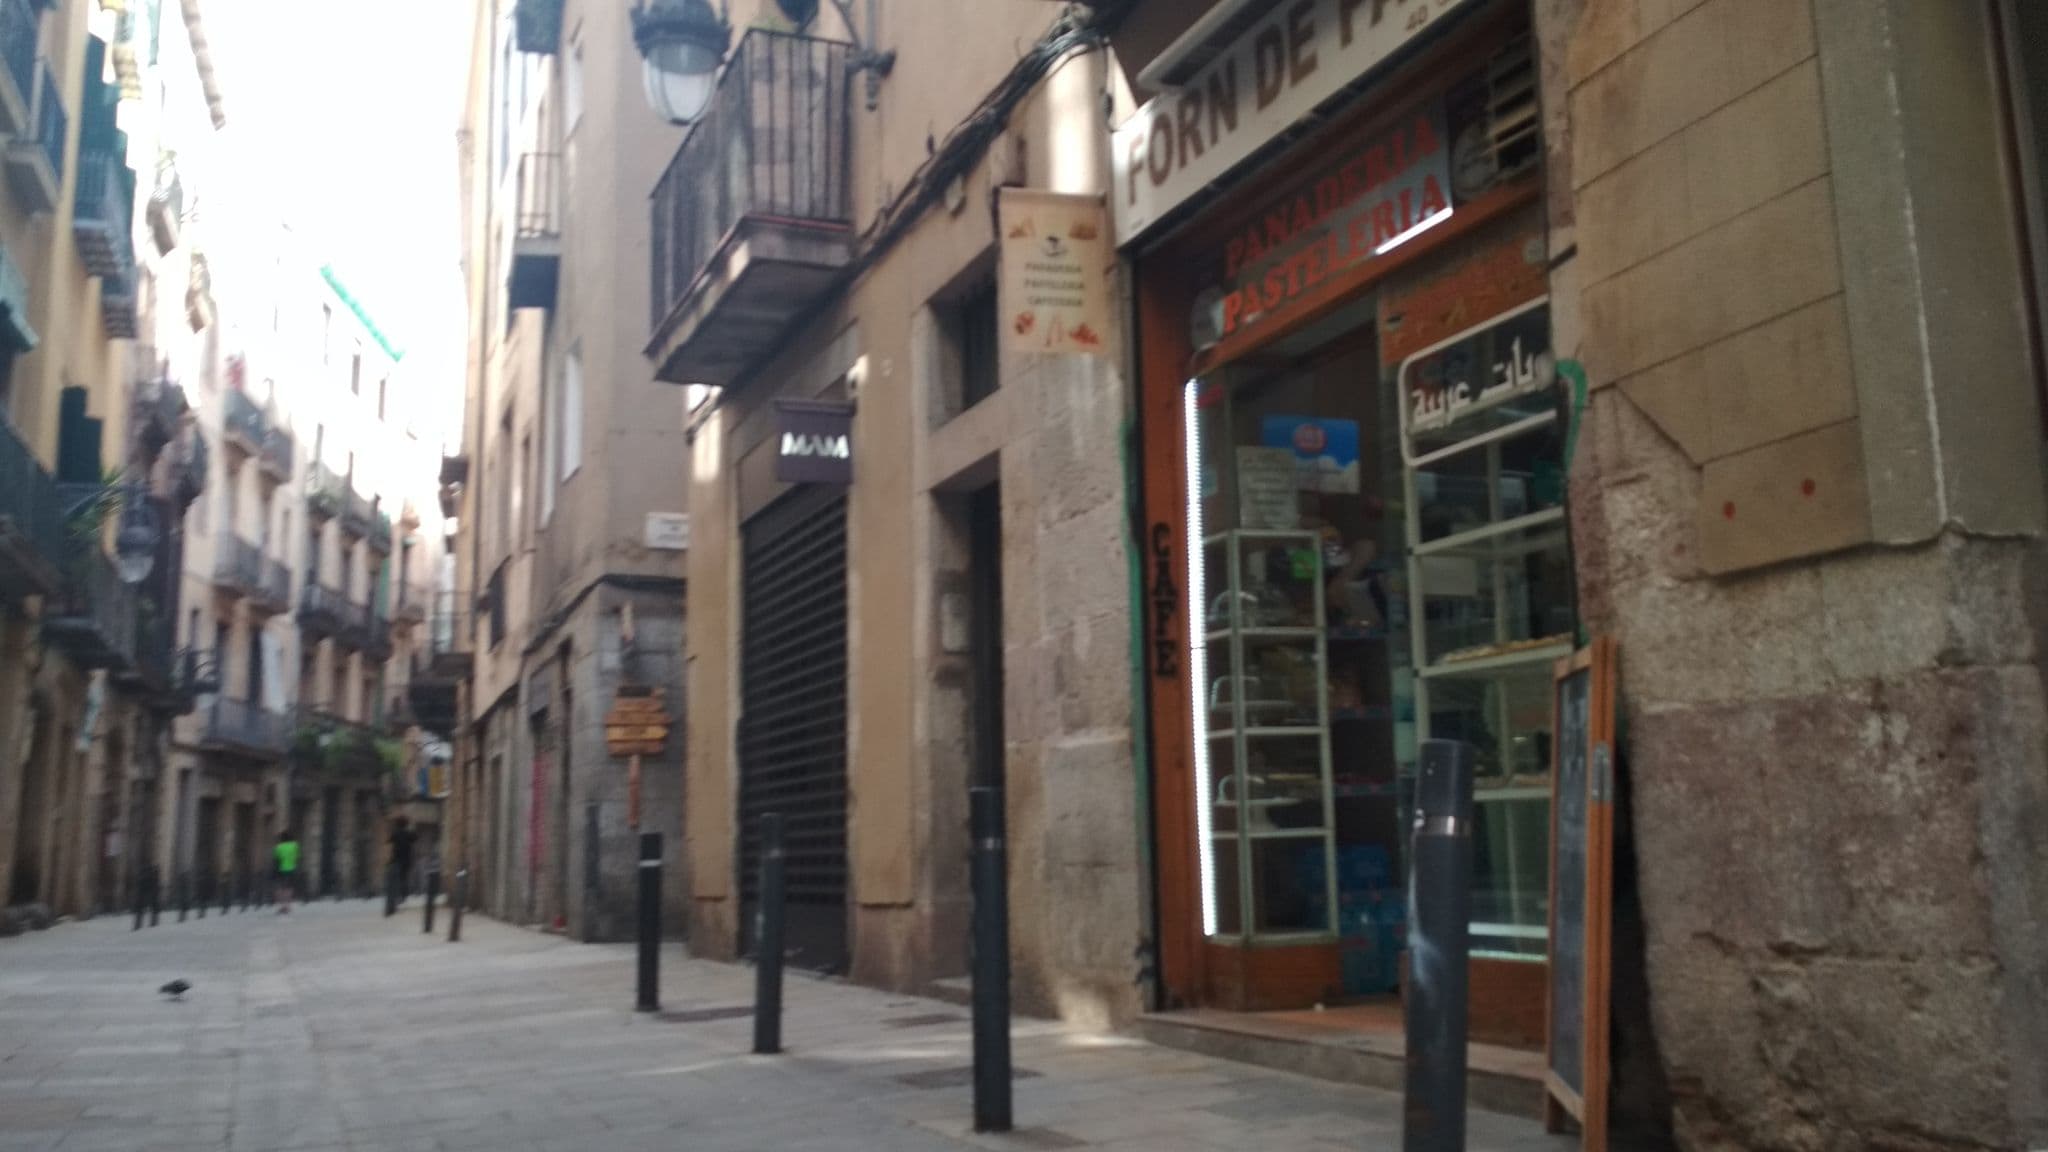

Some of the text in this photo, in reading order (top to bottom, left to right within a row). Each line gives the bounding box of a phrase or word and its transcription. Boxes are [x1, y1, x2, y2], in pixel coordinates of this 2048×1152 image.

[1128, 57, 1238, 206] FORN
[1255, 0, 1318, 111] DE
[1223, 174, 1446, 333] PASTELERIA
[1153, 521, 1178, 678] CAFE
